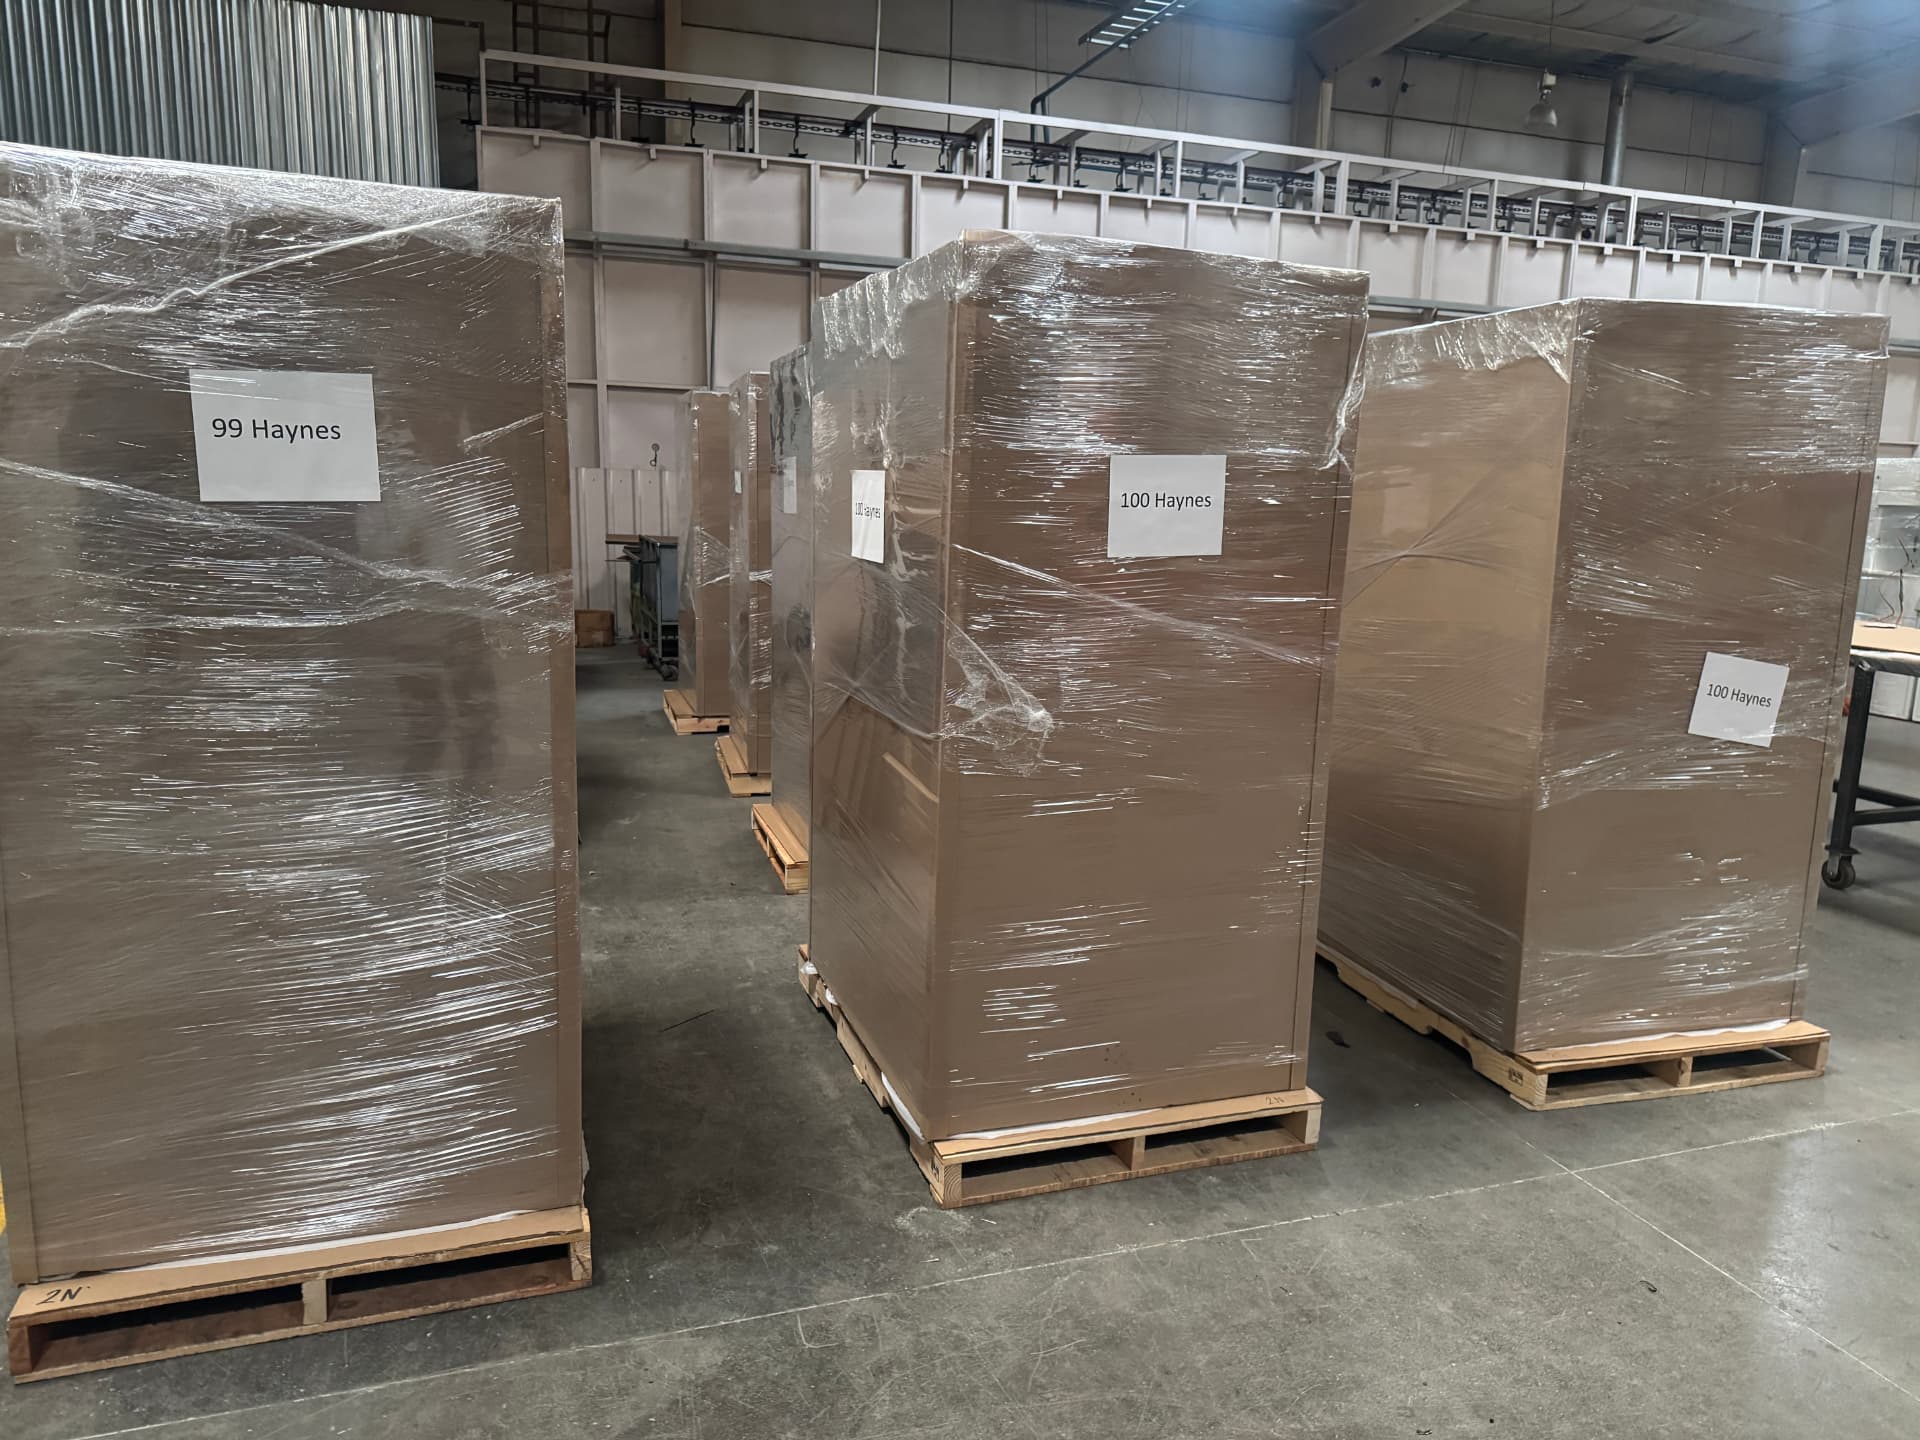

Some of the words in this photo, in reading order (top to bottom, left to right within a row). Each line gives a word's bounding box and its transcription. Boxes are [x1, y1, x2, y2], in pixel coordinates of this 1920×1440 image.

[212, 418, 243, 438] 99
[252, 419, 341, 443] Haynes
[1121, 492, 1150, 508] 100
[1155, 492, 1212, 511] Haynes
[1706, 683, 1729, 699] 100
[1730, 688, 1772, 708] Haynes
